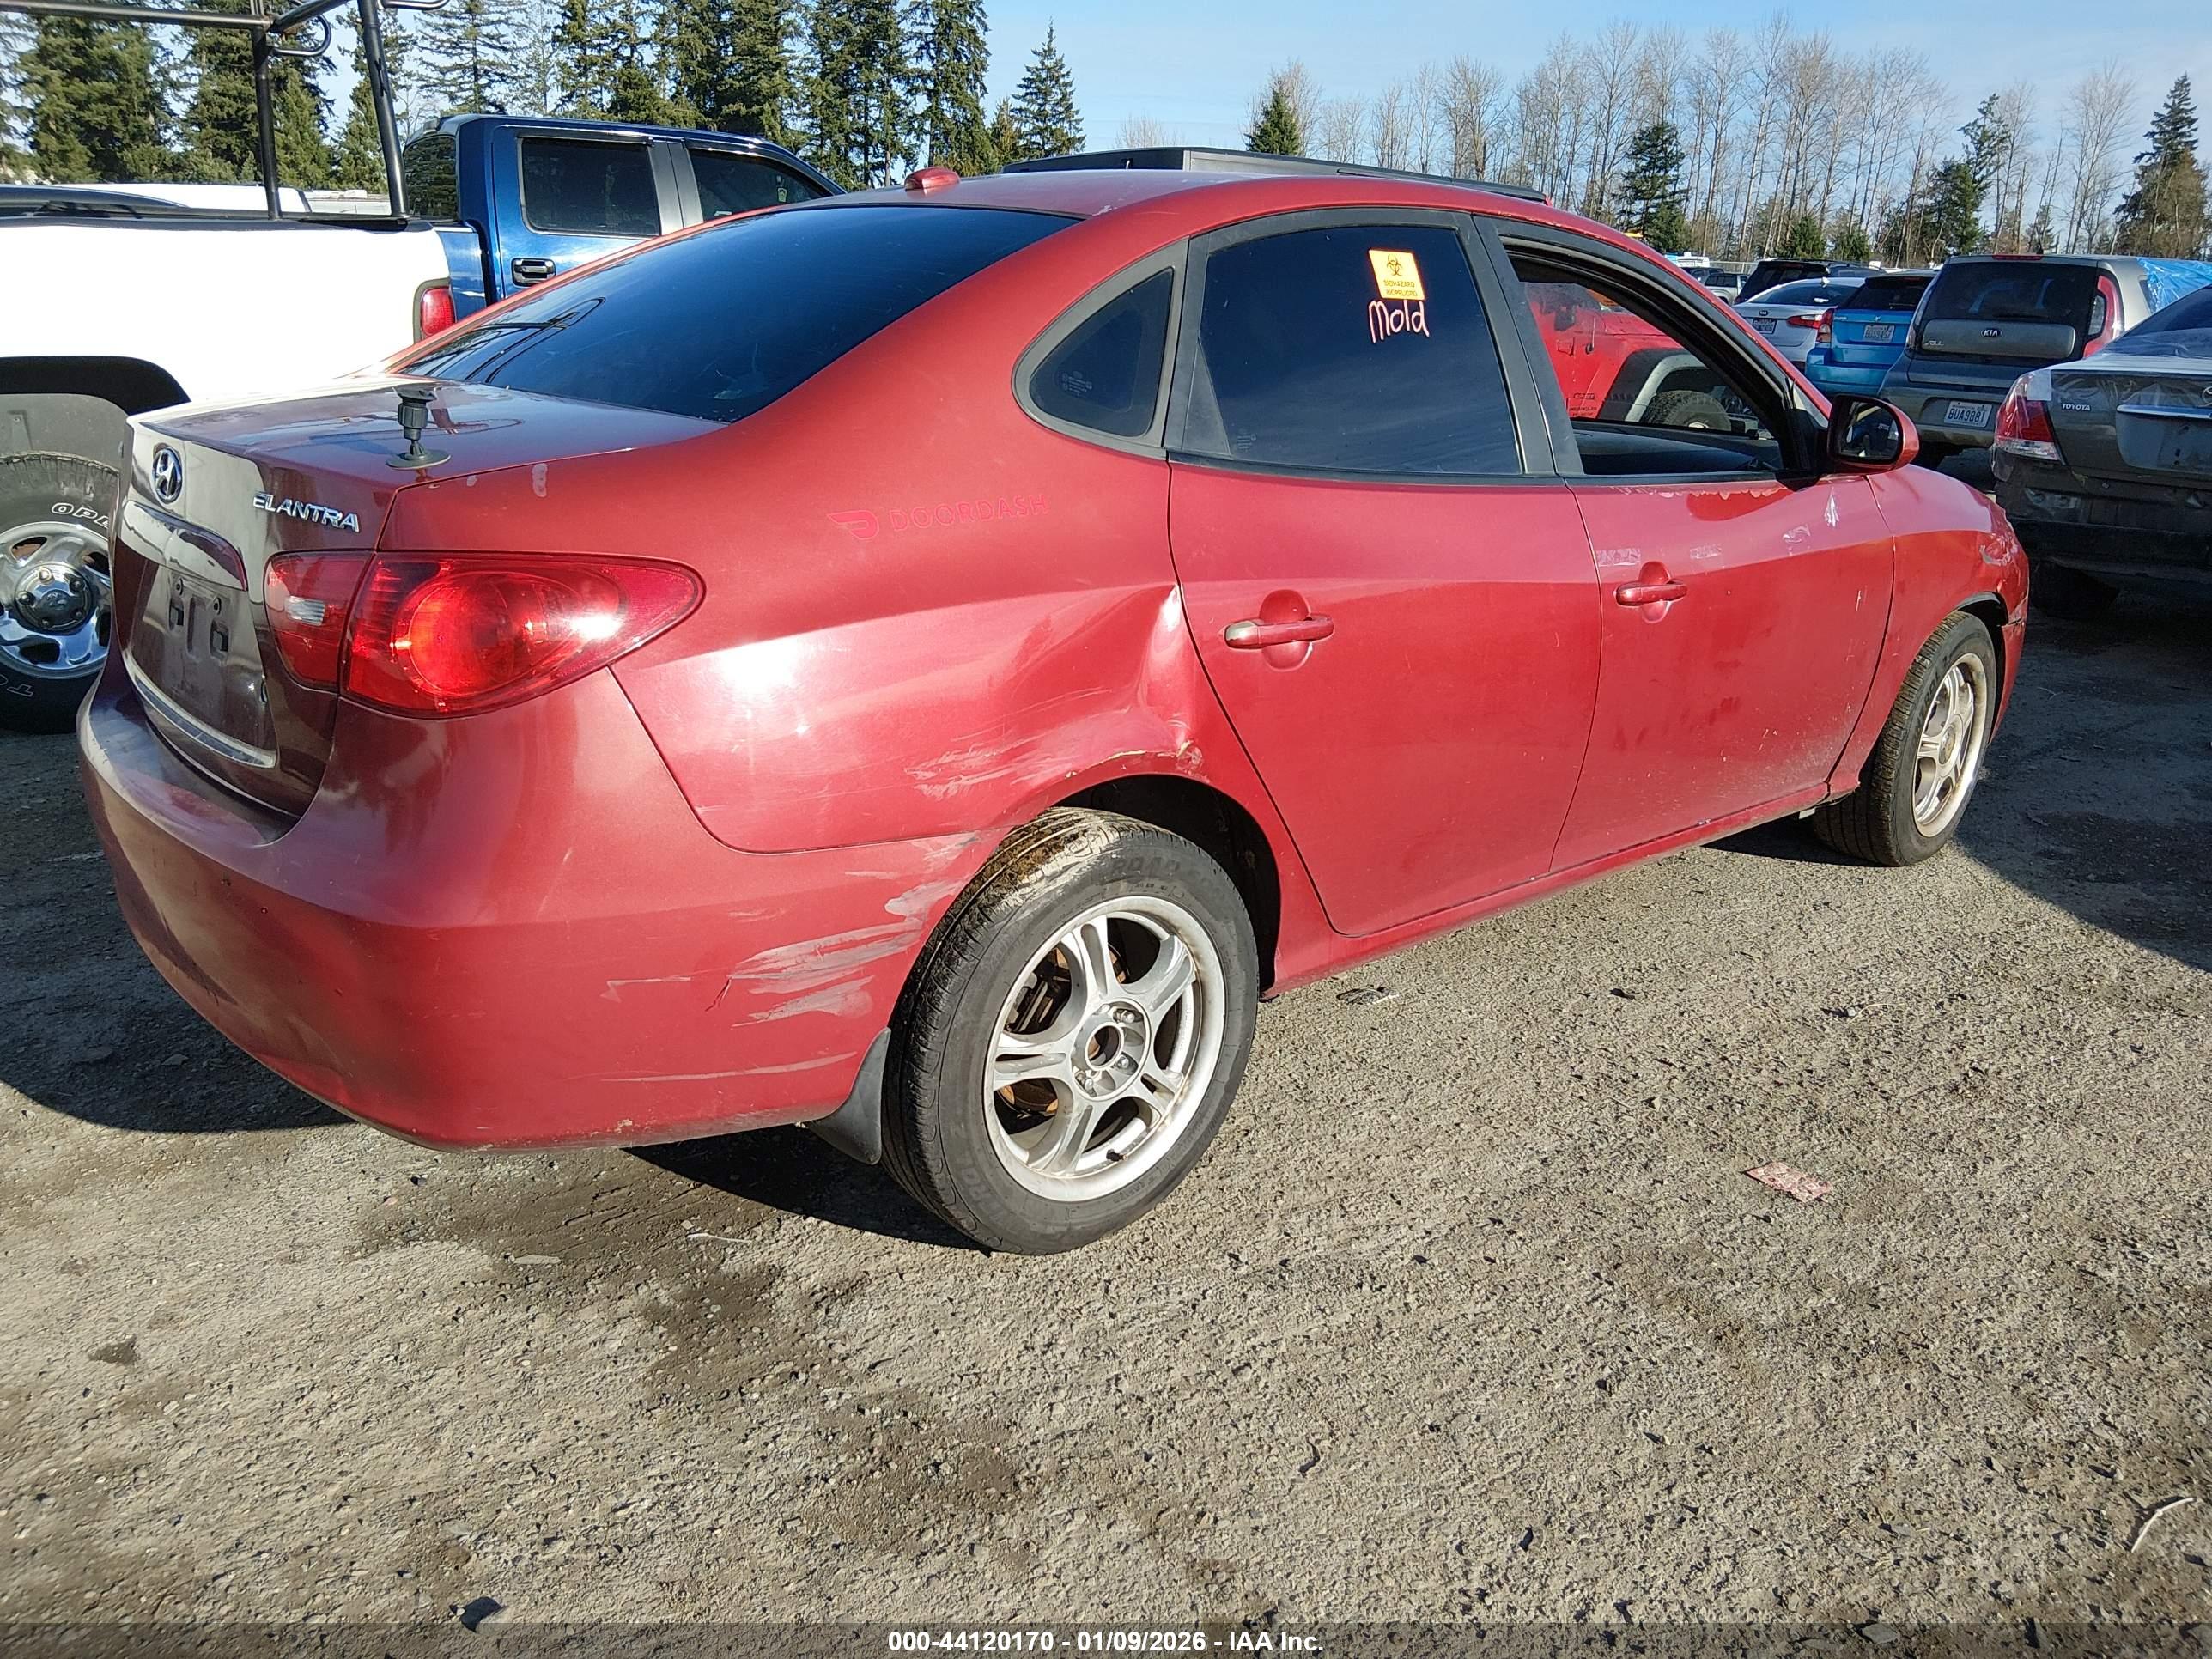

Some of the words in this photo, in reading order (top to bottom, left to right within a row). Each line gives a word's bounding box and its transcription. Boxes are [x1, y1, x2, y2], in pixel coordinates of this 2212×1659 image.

[2061, 403, 2091, 411] TOYOTA
[252, 491, 360, 532] ELANTRA
[889, 493, 1048, 532] DOORDASH
